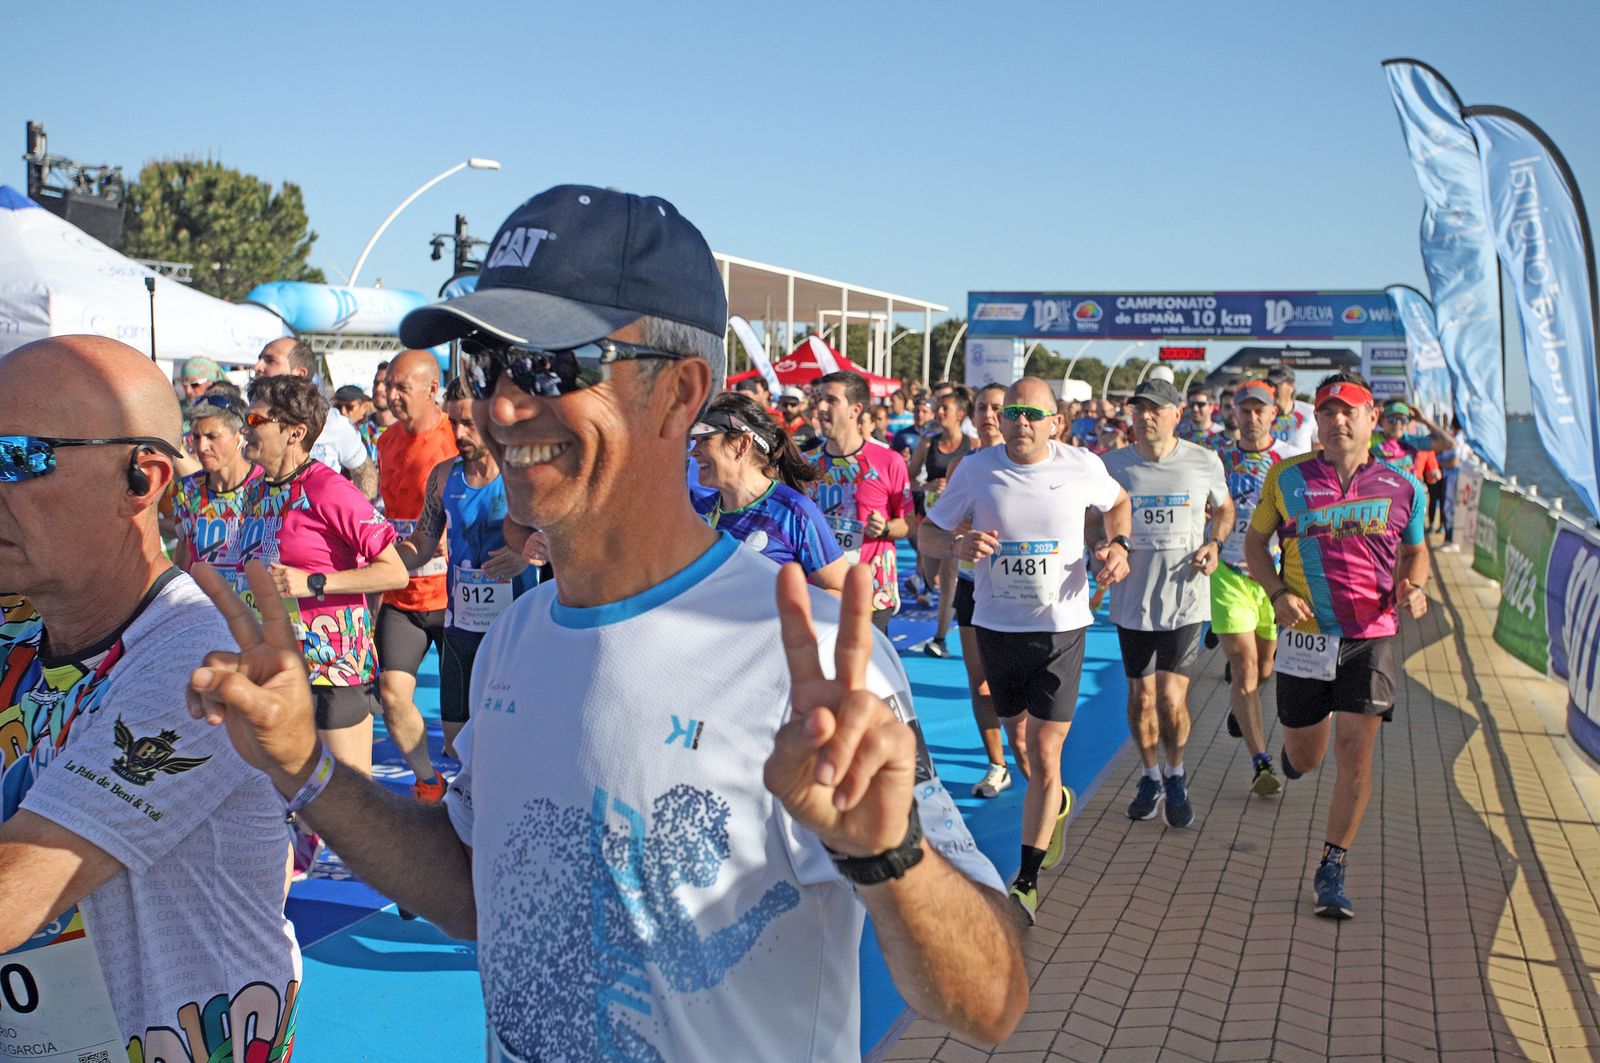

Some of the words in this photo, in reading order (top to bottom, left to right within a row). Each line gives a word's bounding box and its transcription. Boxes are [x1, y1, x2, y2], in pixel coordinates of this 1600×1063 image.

[487, 227, 549, 268] CAT
[1116, 296, 1217, 310] CAMPEONATO
[1115, 312, 1131, 324] de
[1134, 310, 1184, 324] ESPAÑA
[1191, 310, 1216, 326] 10
[1220, 308, 1252, 326] km
[1144, 508, 1175, 525] 951
[1034, 543, 1054, 553] 2023
[1000, 557, 1048, 577] 1481
[462, 585, 495, 604] 912
[1285, 630, 1326, 653] 1003
[64, 760, 76, 771] La
[96, 776, 110, 788] de
[110, 783, 135, 803] Beni
[7, 1041, 58, 1056] GARCIA
